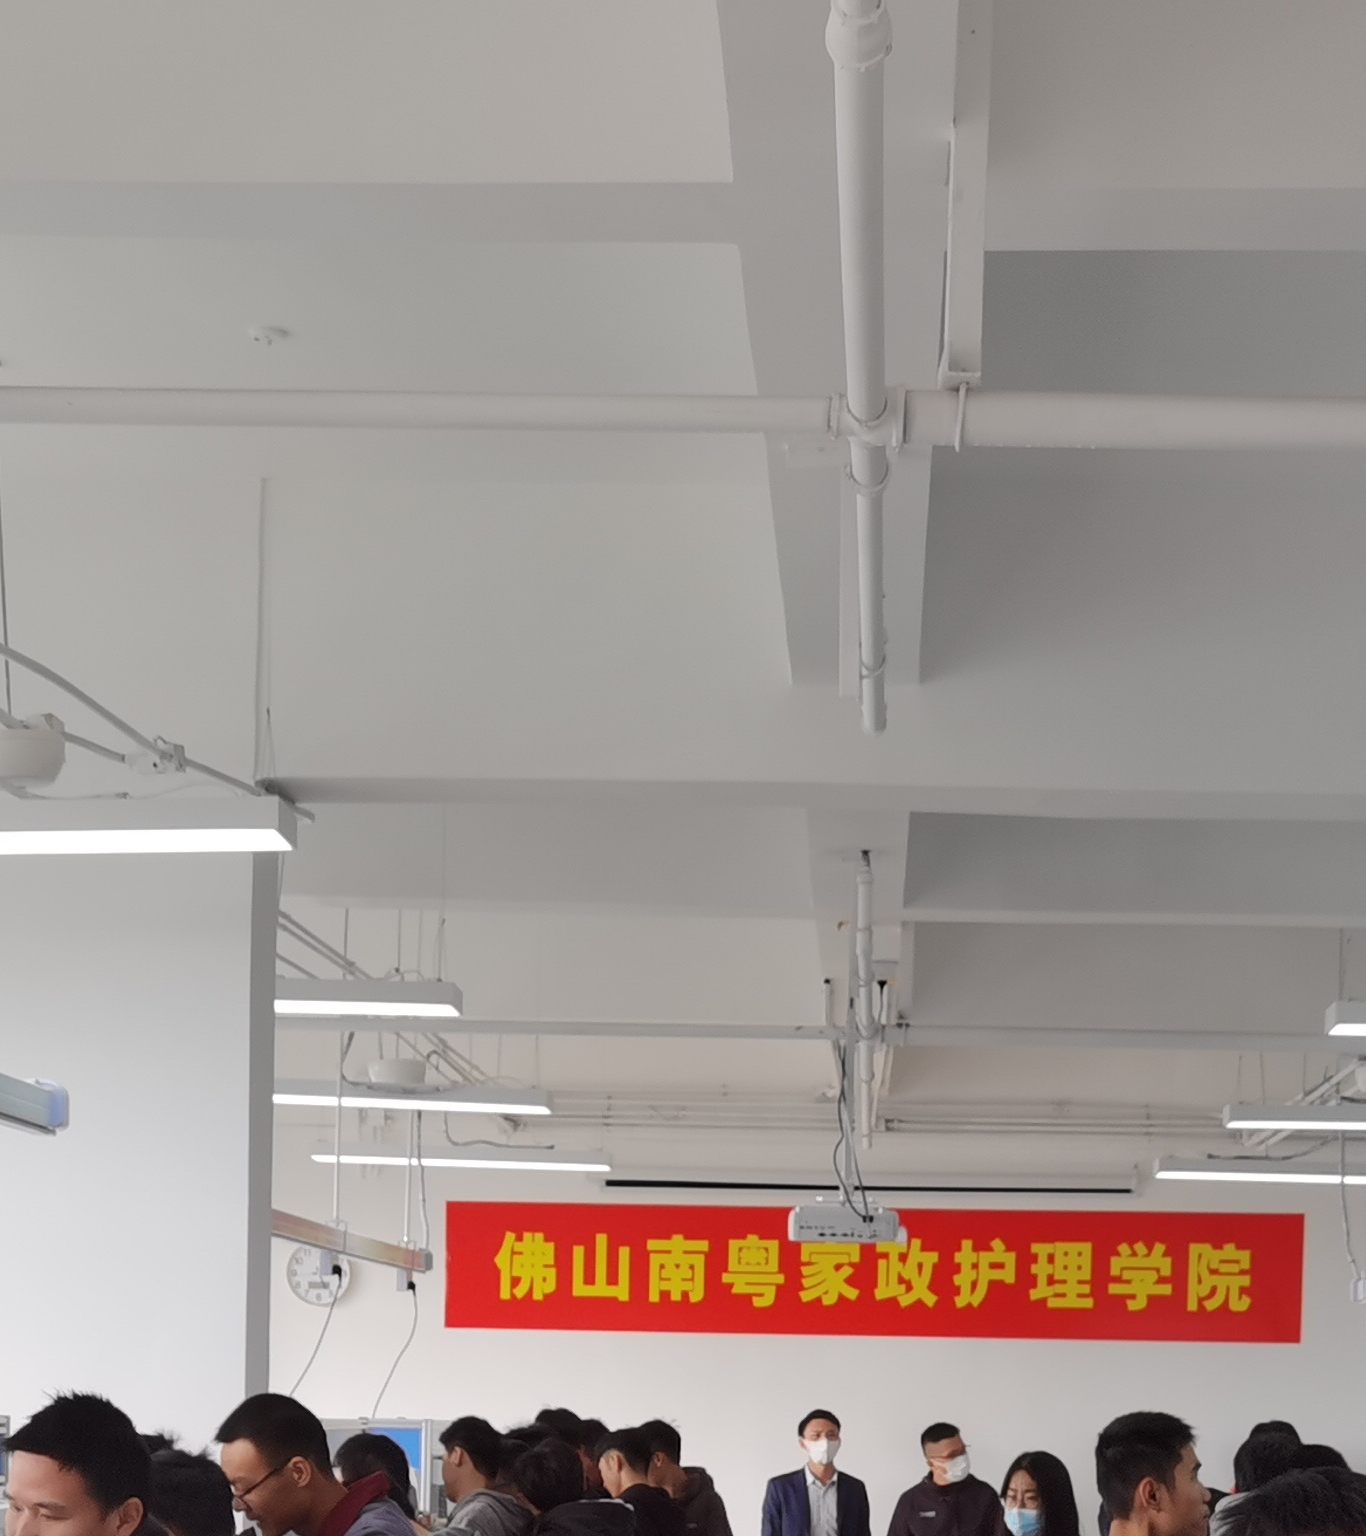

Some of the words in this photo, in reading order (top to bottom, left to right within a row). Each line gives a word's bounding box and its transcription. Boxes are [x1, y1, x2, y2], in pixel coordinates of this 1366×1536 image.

[495, 1229, 1254, 1313] 佛山南粤家政护理学院
